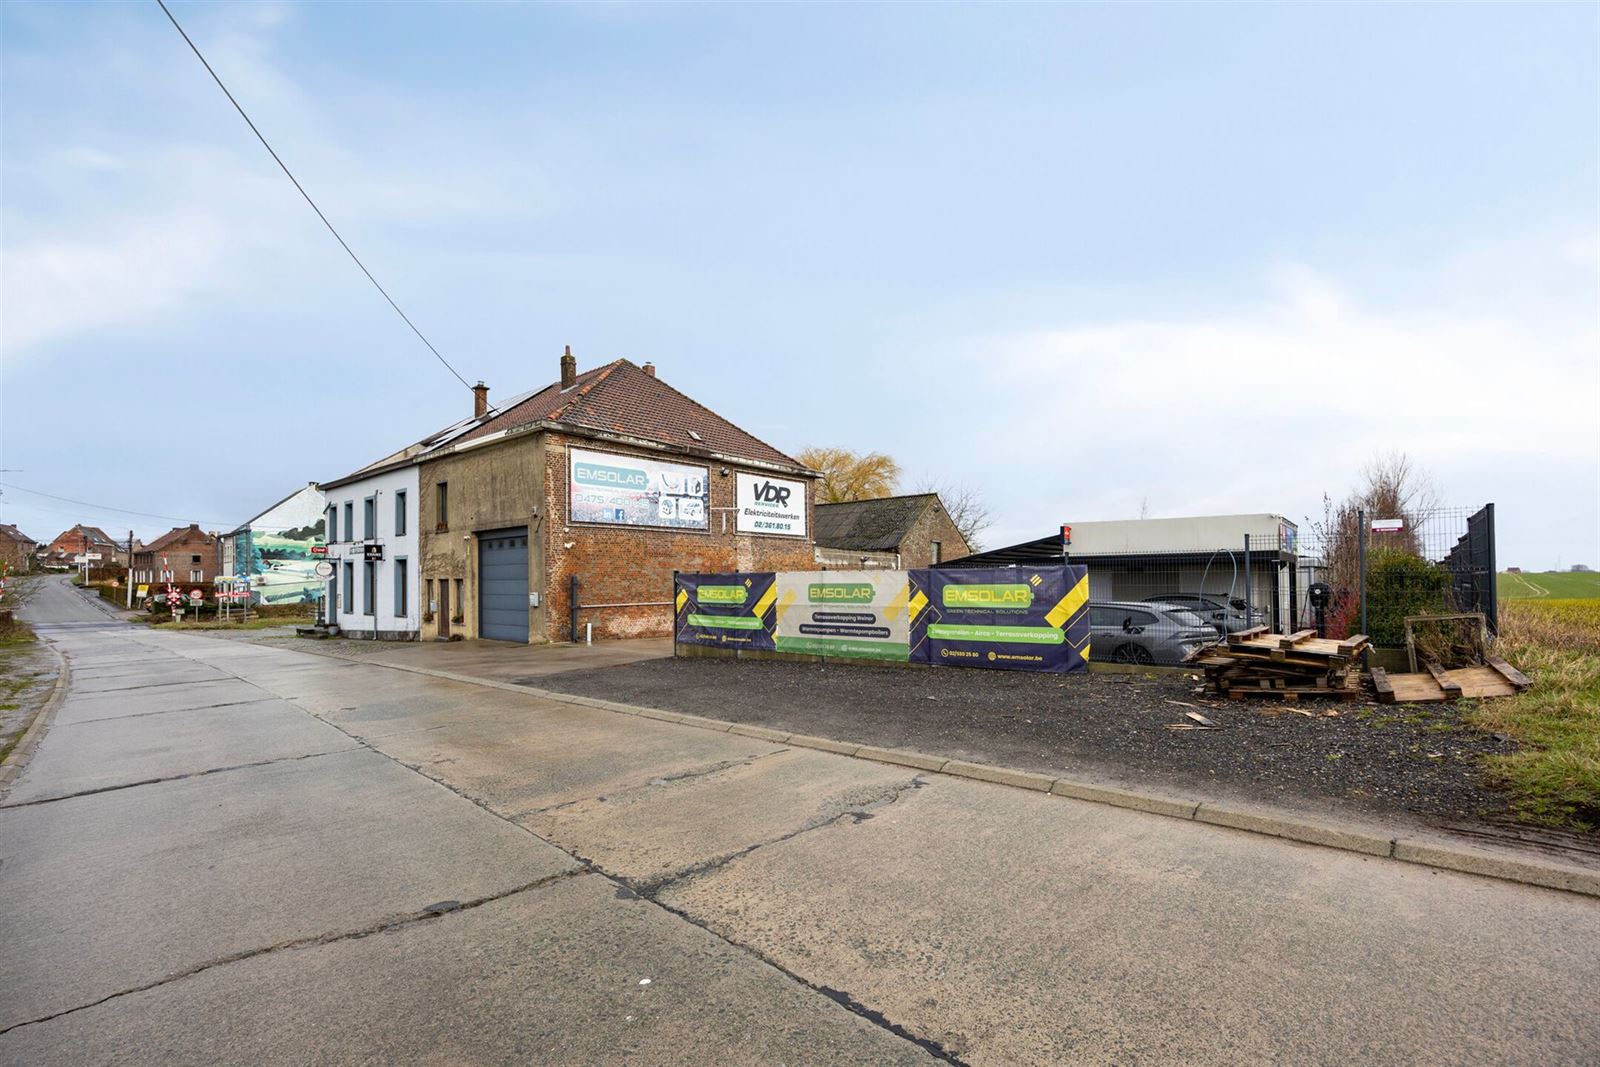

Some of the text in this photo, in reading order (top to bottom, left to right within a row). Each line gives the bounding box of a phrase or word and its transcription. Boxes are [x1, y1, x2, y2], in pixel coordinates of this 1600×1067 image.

[576, 467, 645, 486] EMSOLAR
[753, 480, 791, 508] VDR
[744, 507, 800, 520] Elektriciteitswerken
[699, 588, 744, 599] EMSOLAR
[810, 587, 871, 599] EMSOLAR
[944, 589, 1028, 603] EMSOLAR
[996, 630, 1059, 640] Terrasoverkapping
